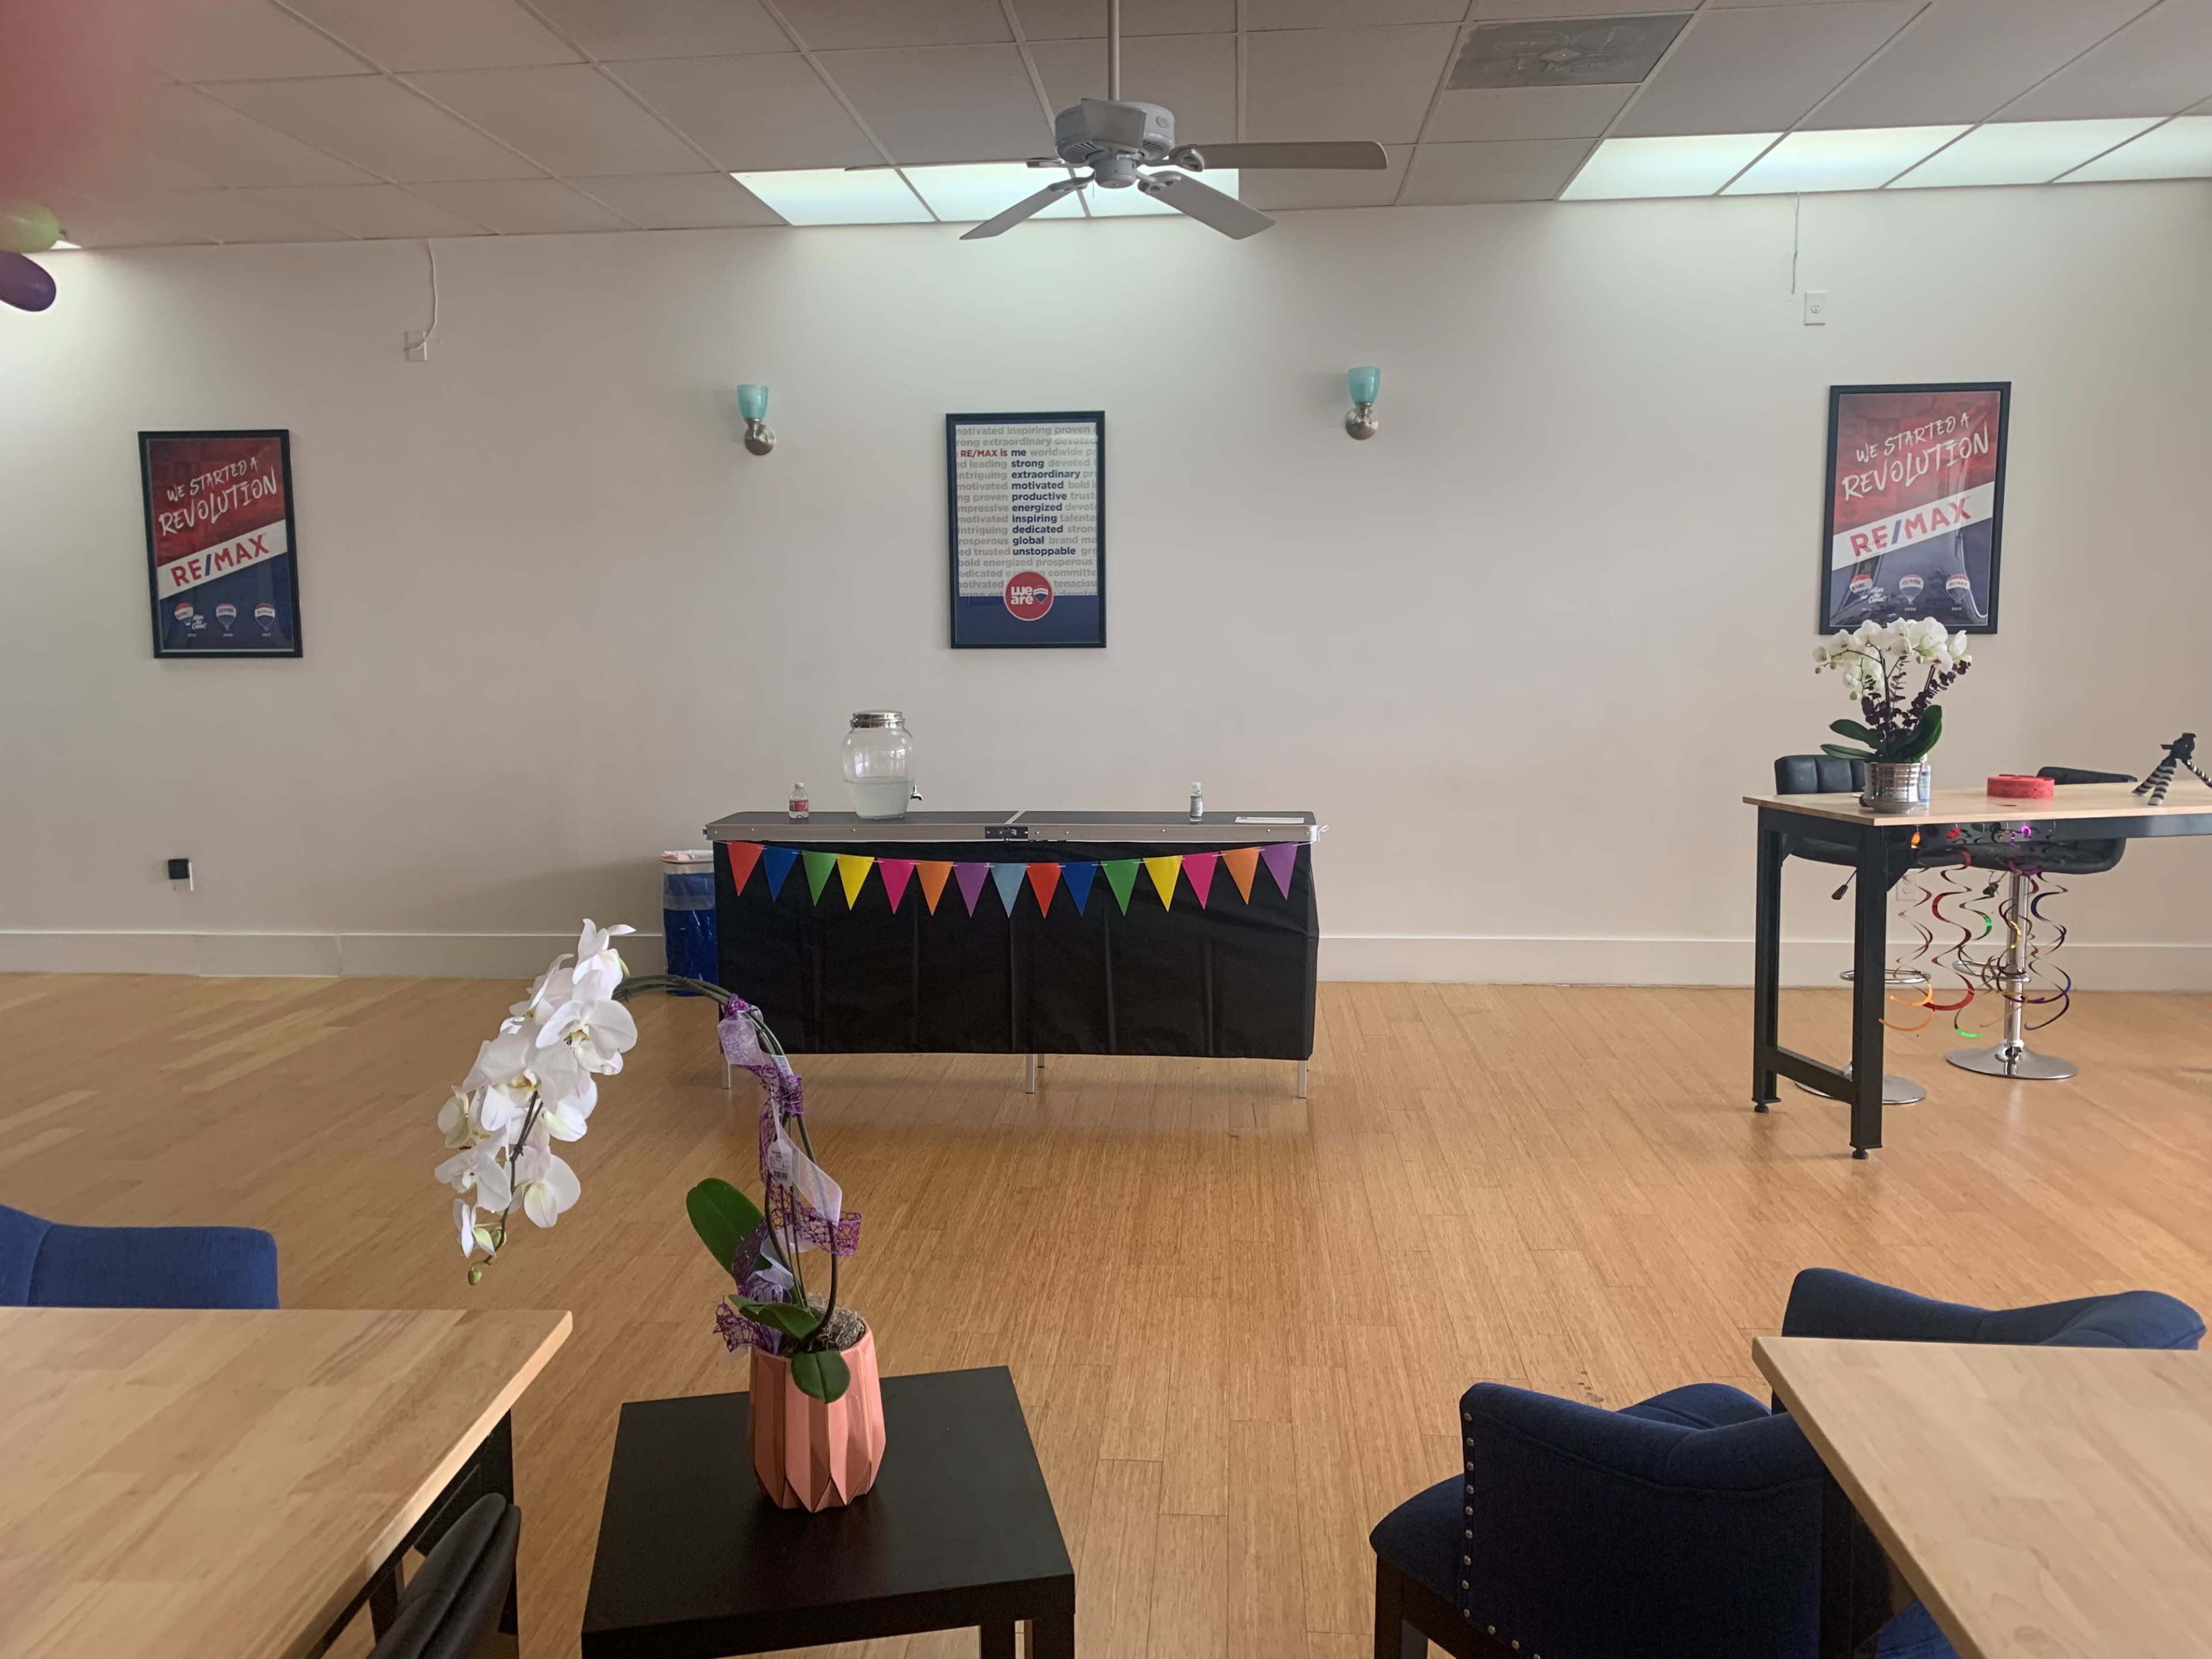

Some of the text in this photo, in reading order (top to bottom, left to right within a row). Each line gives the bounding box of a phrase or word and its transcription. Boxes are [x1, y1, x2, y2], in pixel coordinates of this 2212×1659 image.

[1007, 426, 1051, 435] inspiring
[1054, 427, 1090, 435] proven
[983, 437, 1052, 448] extraordinary
[1857, 412, 1969, 463] WE STARTED A
[960, 449, 998, 458] RE/MAX
[1000, 449, 1008, 457] is
[1030, 448, 1083, 456] worldwide
[970, 459, 1007, 469] leading
[1011, 460, 1044, 469] strong
[1048, 459, 1090, 467] devoted
[1842, 419, 1988, 501] REVOLUTION
[167, 456, 257, 501] WE STARTED A
[1012, 469, 1081, 480] extraordinary
[957, 480, 1090, 491] motivated motivated bold
[158, 465, 276, 536] REVOLUTION
[973, 495, 1009, 503] proven
[1012, 492, 1067, 503] productive
[1012, 503, 1063, 513] energized
[958, 514, 1009, 524] motivated
[1012, 514, 1058, 524] inspiring
[959, 525, 1008, 536] intriguing
[1013, 524, 1063, 534] dedicated
[1850, 498, 1971, 557] RE/MAX
[1013, 535, 1044, 546] global
[1049, 535, 1078, 544] brand
[974, 548, 1010, 556] trusted
[1013, 546, 1076, 556] unstoppable
[171, 534, 269, 586] RE/MAX
[983, 558, 1033, 568] energized
[1036, 558, 1093, 567] prosperous
[1011, 586, 1032, 596] we
[1010, 595, 1033, 605] are
